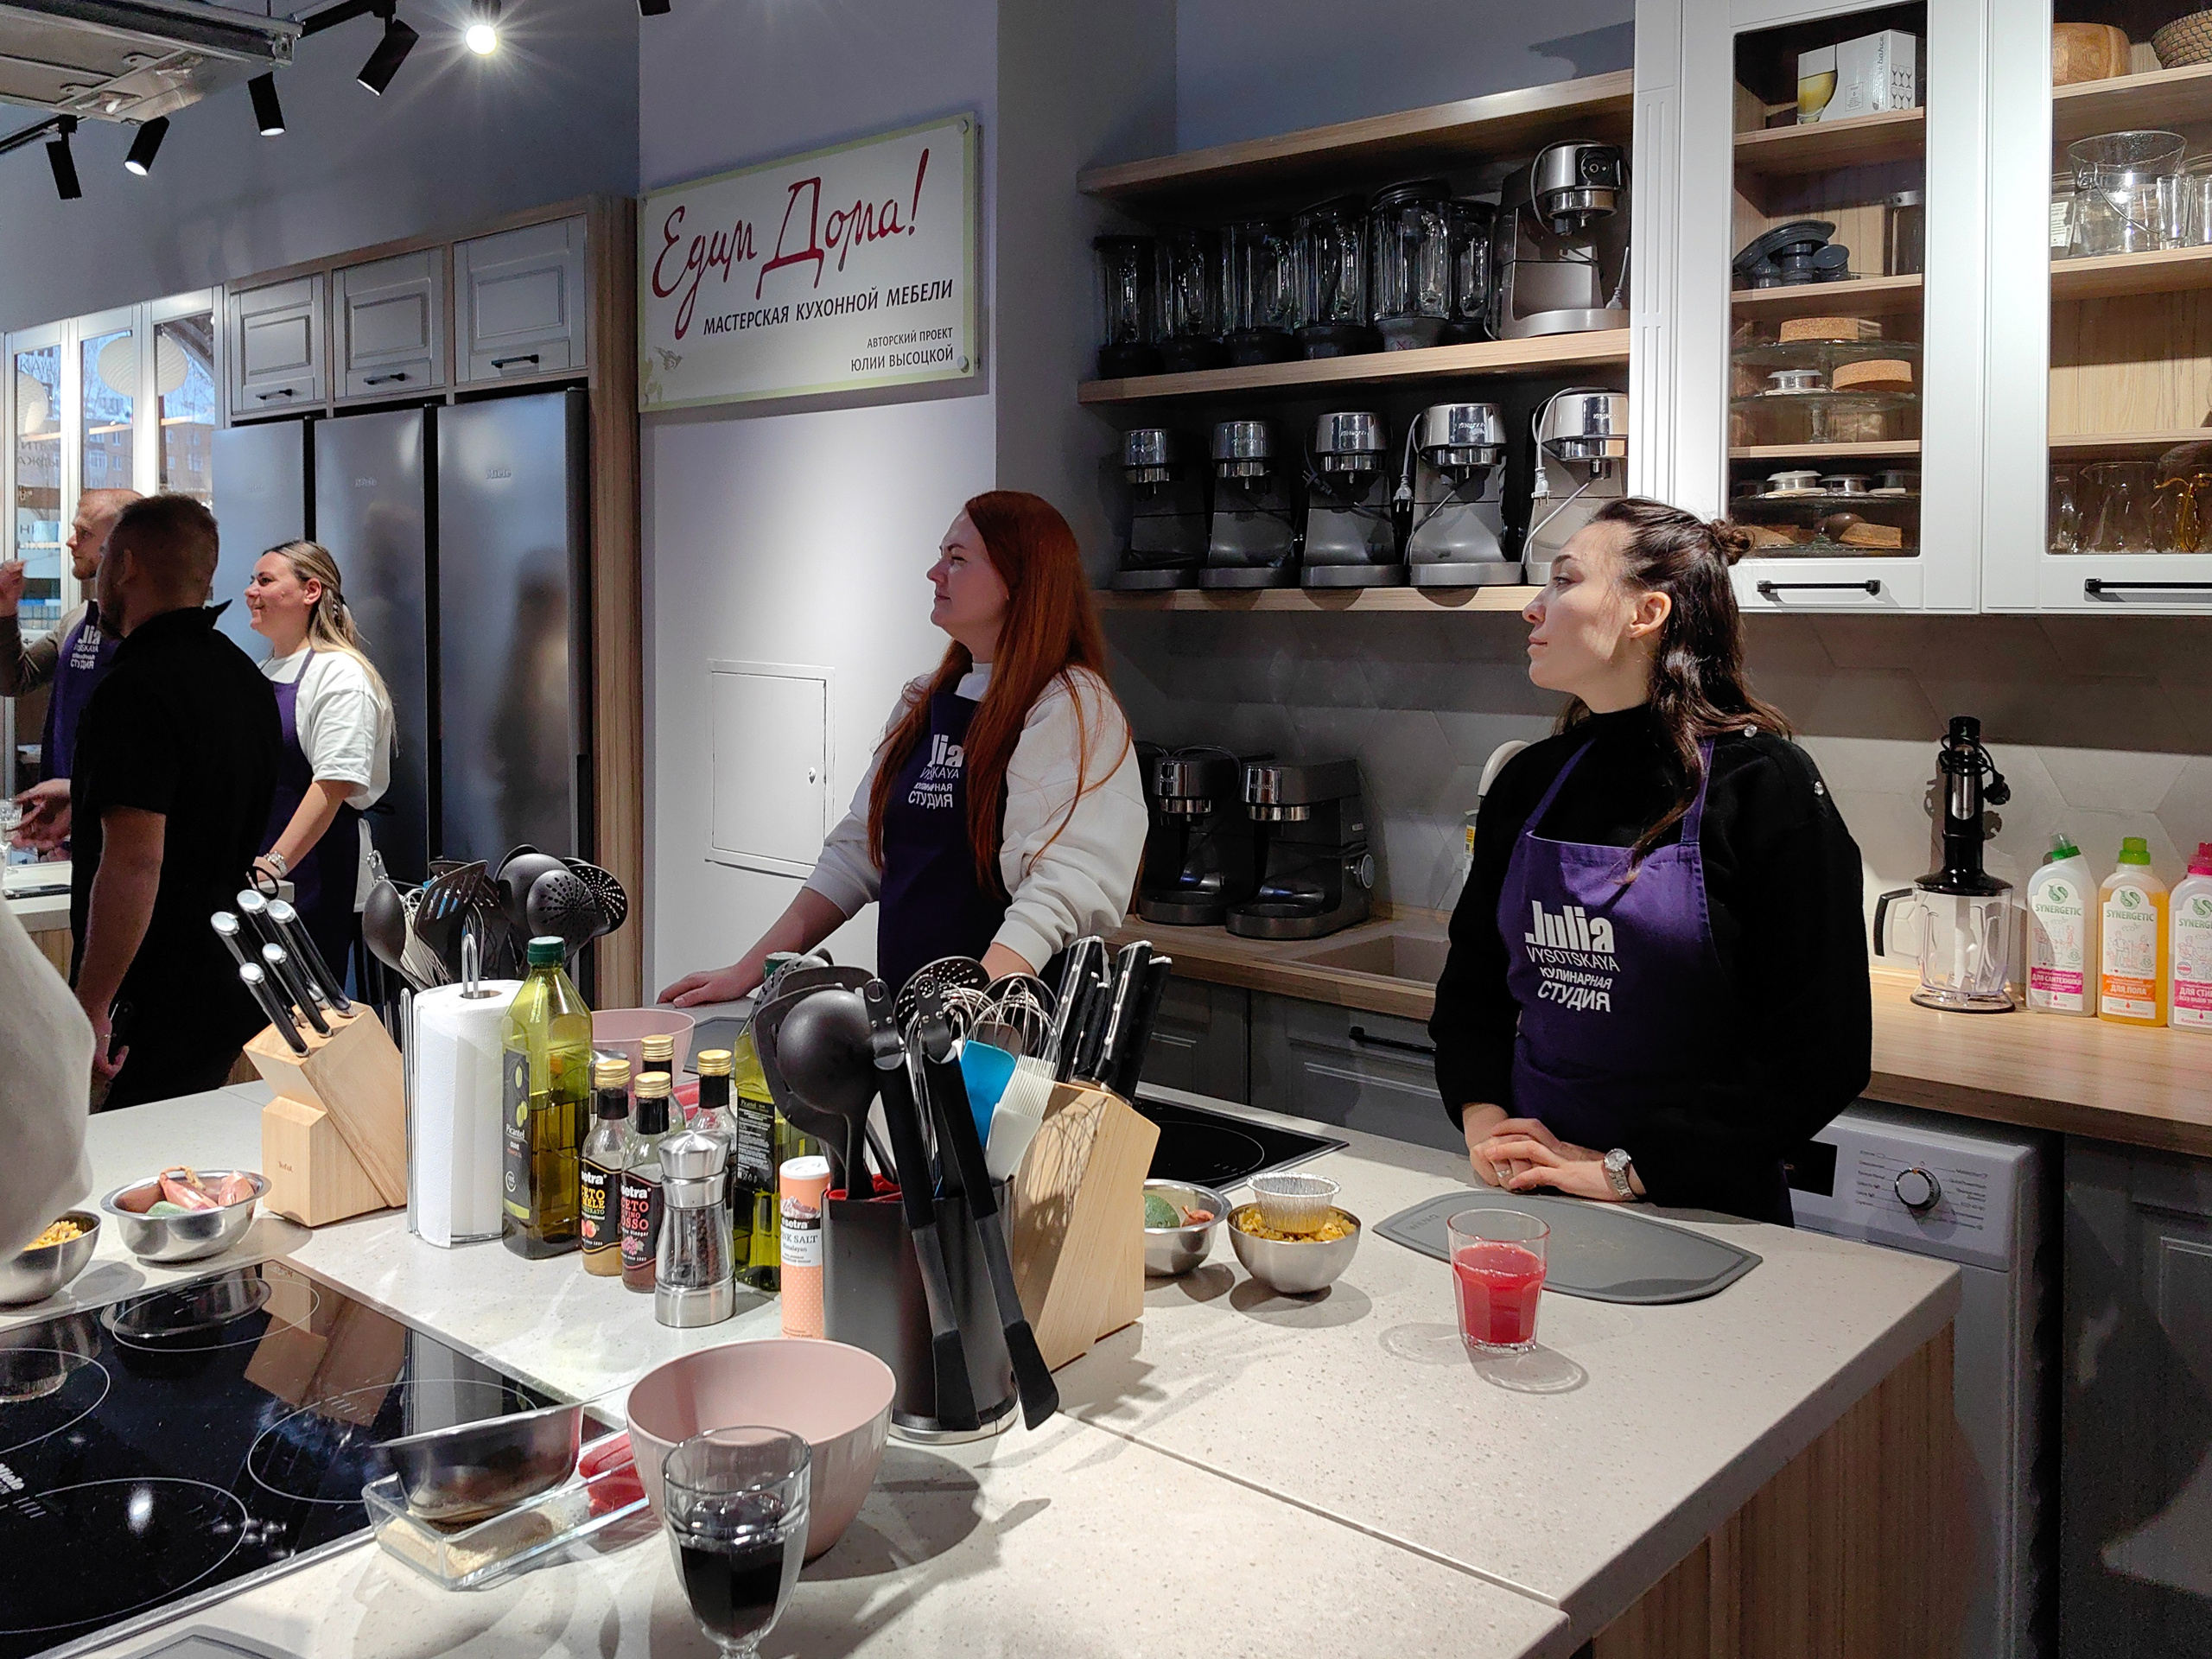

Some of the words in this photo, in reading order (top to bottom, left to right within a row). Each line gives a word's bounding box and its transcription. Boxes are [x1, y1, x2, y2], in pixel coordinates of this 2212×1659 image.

[652, 205, 758, 340] Едим
[755, 148, 930, 301] Дома!
[702, 305, 790, 335] МАСТЕРСКАЯ
[795, 287, 879, 321] КУХОННОЙ
[886, 279, 953, 308] МЕБЕЛИ
[867, 331, 918, 349] АВТОРСКИЙ
[918, 327, 953, 342] ПРОЕКТ
[850, 355, 886, 372] ЮЛИИ
[888, 346, 954, 369] ВЫСОЦКОЙ
[78, 624, 102, 645] lia
[927, 734, 965, 767] lia
[907, 790, 954, 810] СТУДИЯ
[2035, 904, 2082, 916] SYNERGETIC
[2107, 909, 2154, 922] SYNERGETIC
[1524, 899, 1615, 954] Julia
[1526, 945, 1622, 973] VYSOTSKAYA
[1539, 966, 1613, 990] КУЛИНАРНАЯ
[2110, 983, 2126, 994] ДЛЯ
[2126, 985, 2147, 995] ПОЛА
[1537, 980, 1611, 1013] СТУДИЯ
[2179, 987, 2196, 996] ДЛЯ
[793, 1235, 818, 1244] SALT
